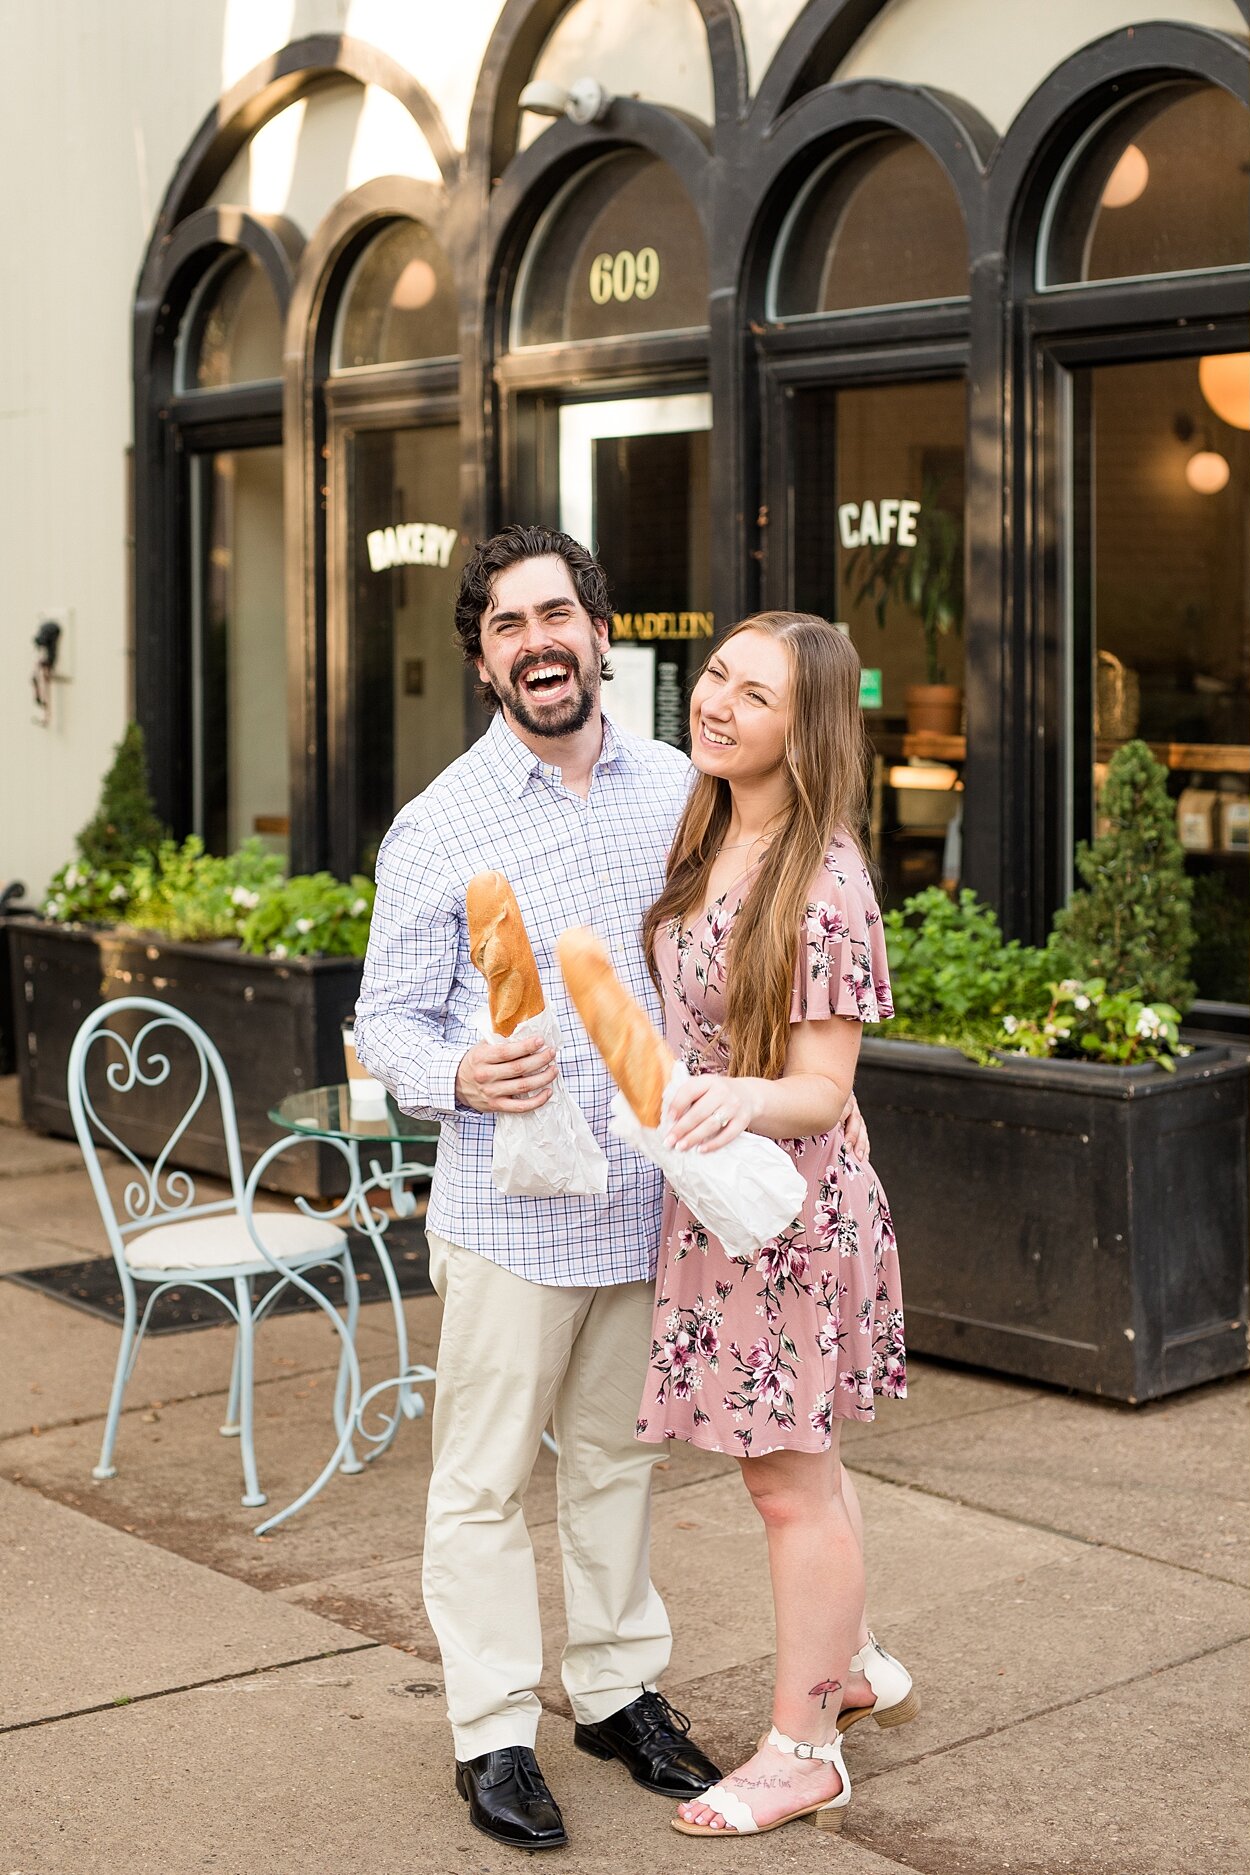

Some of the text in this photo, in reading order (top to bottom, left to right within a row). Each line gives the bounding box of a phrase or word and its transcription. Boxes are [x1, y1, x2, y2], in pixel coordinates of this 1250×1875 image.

[589, 246, 659, 305] 609
[366, 522, 458, 572] BAKERY
[838, 498, 921, 549] CAFE
